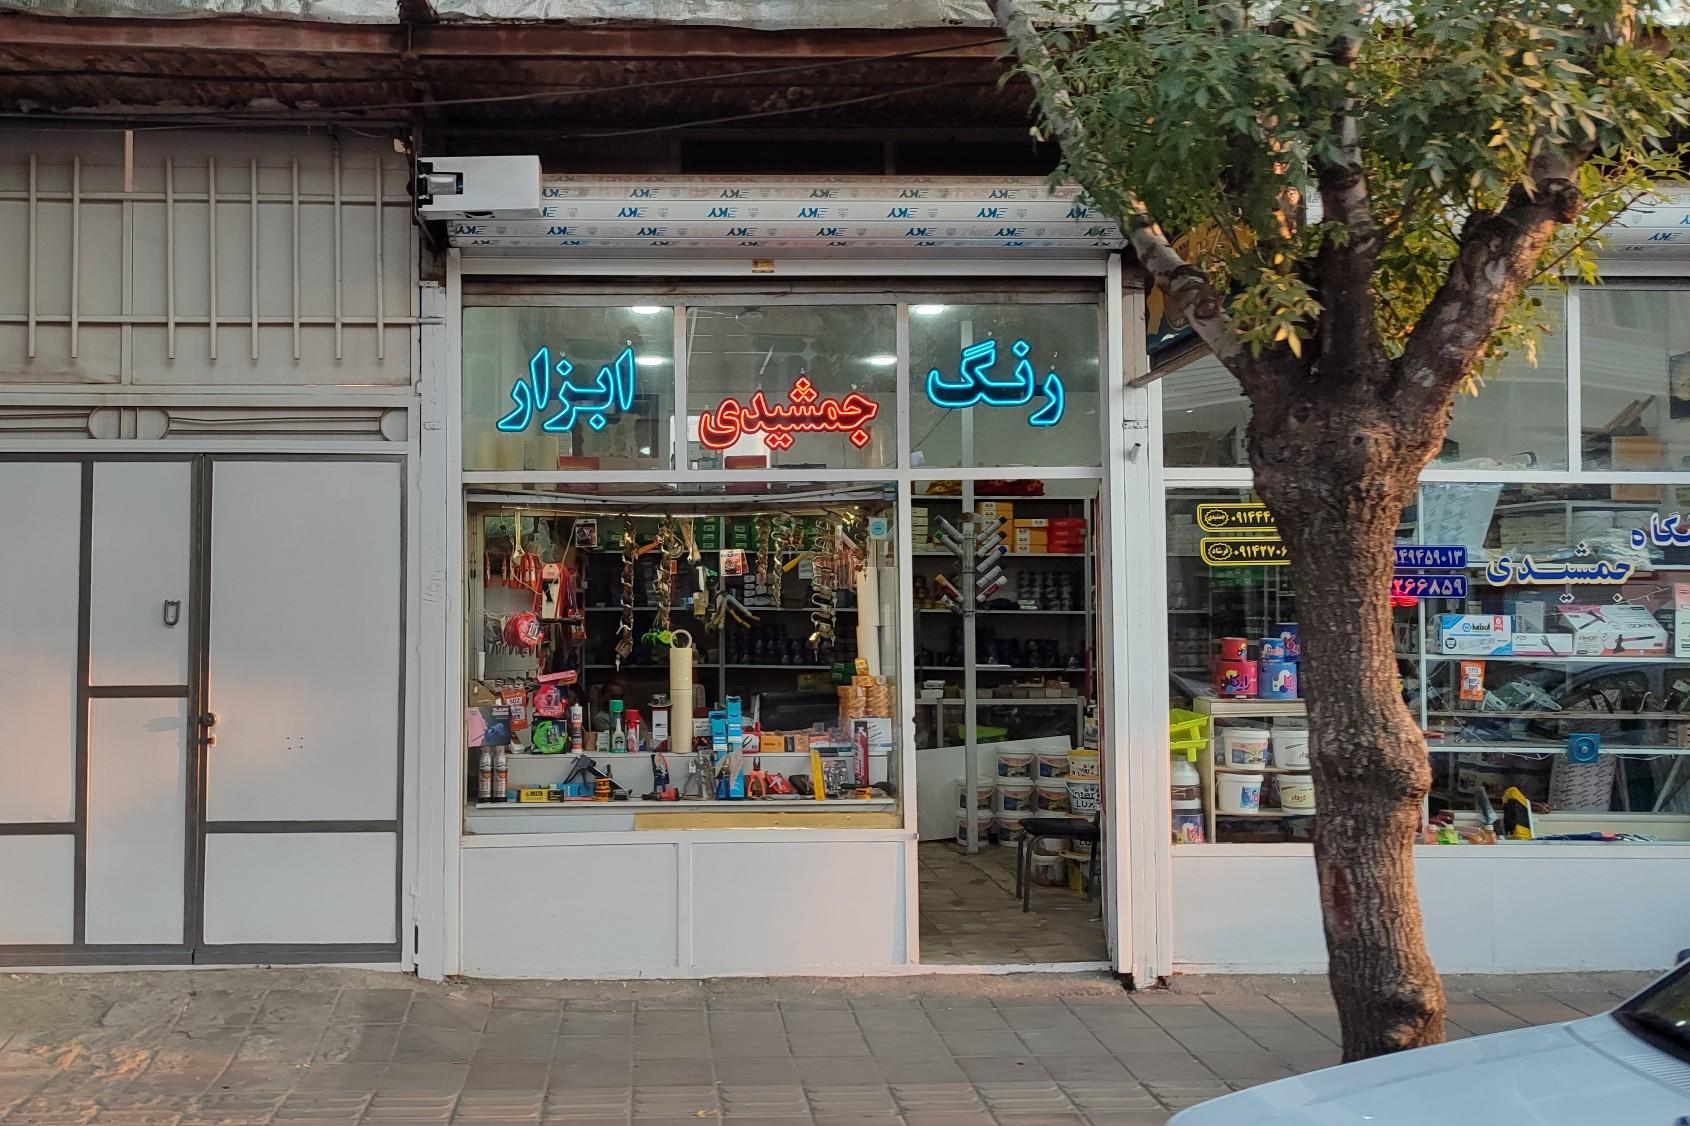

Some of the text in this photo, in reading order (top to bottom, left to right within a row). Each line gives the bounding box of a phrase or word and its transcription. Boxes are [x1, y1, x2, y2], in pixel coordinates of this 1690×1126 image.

[497, 338, 1066, 433] رنگ ابزار
[698, 374, 879, 450] جمشیدی
[1486, 541, 1636, 604] جمشیدی
